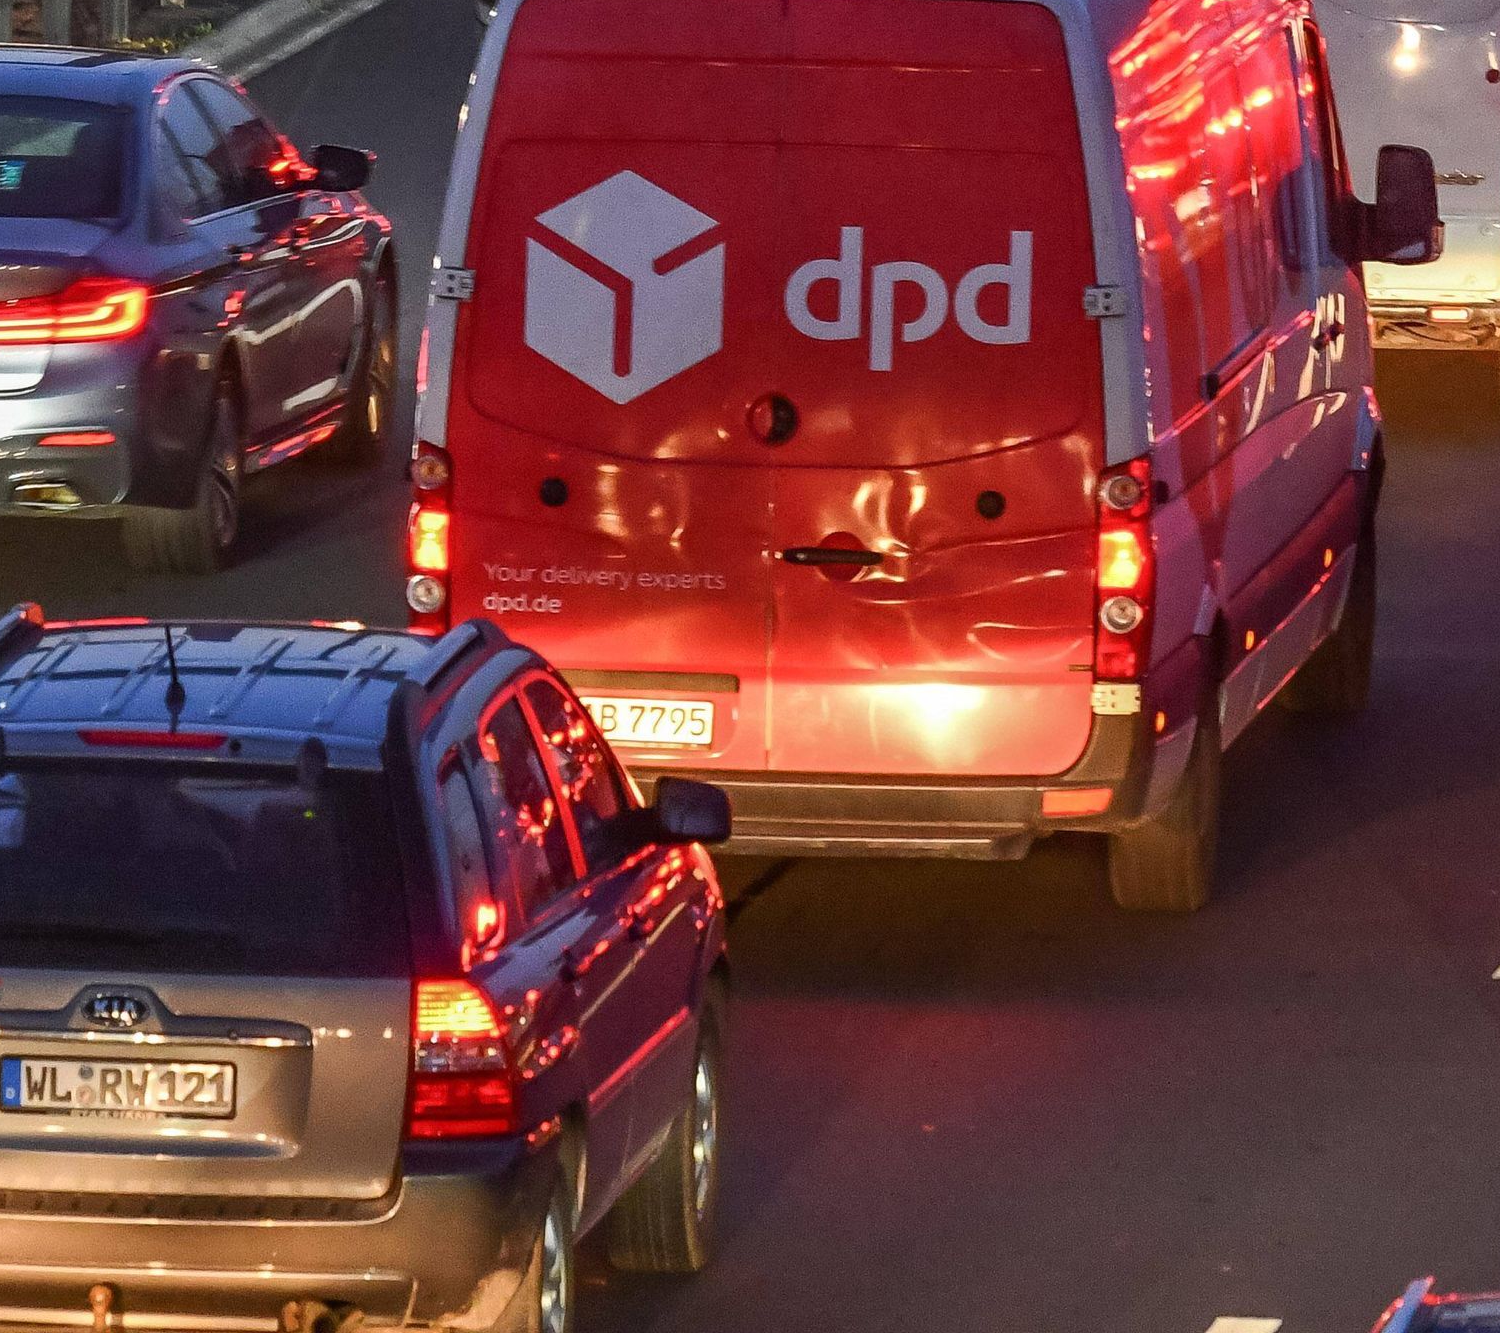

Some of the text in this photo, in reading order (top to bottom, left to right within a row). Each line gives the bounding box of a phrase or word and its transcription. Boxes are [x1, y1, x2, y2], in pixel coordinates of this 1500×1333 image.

[783, 226, 1034, 371] dpd
[483, 563, 727, 593] Your delivery experts
[482, 592, 562, 614] dpd.de
[629, 703, 708, 737] 7795
[24, 1065, 73, 1103] WL
[99, 1067, 149, 1106] RW
[155, 1069, 231, 1108] 121
